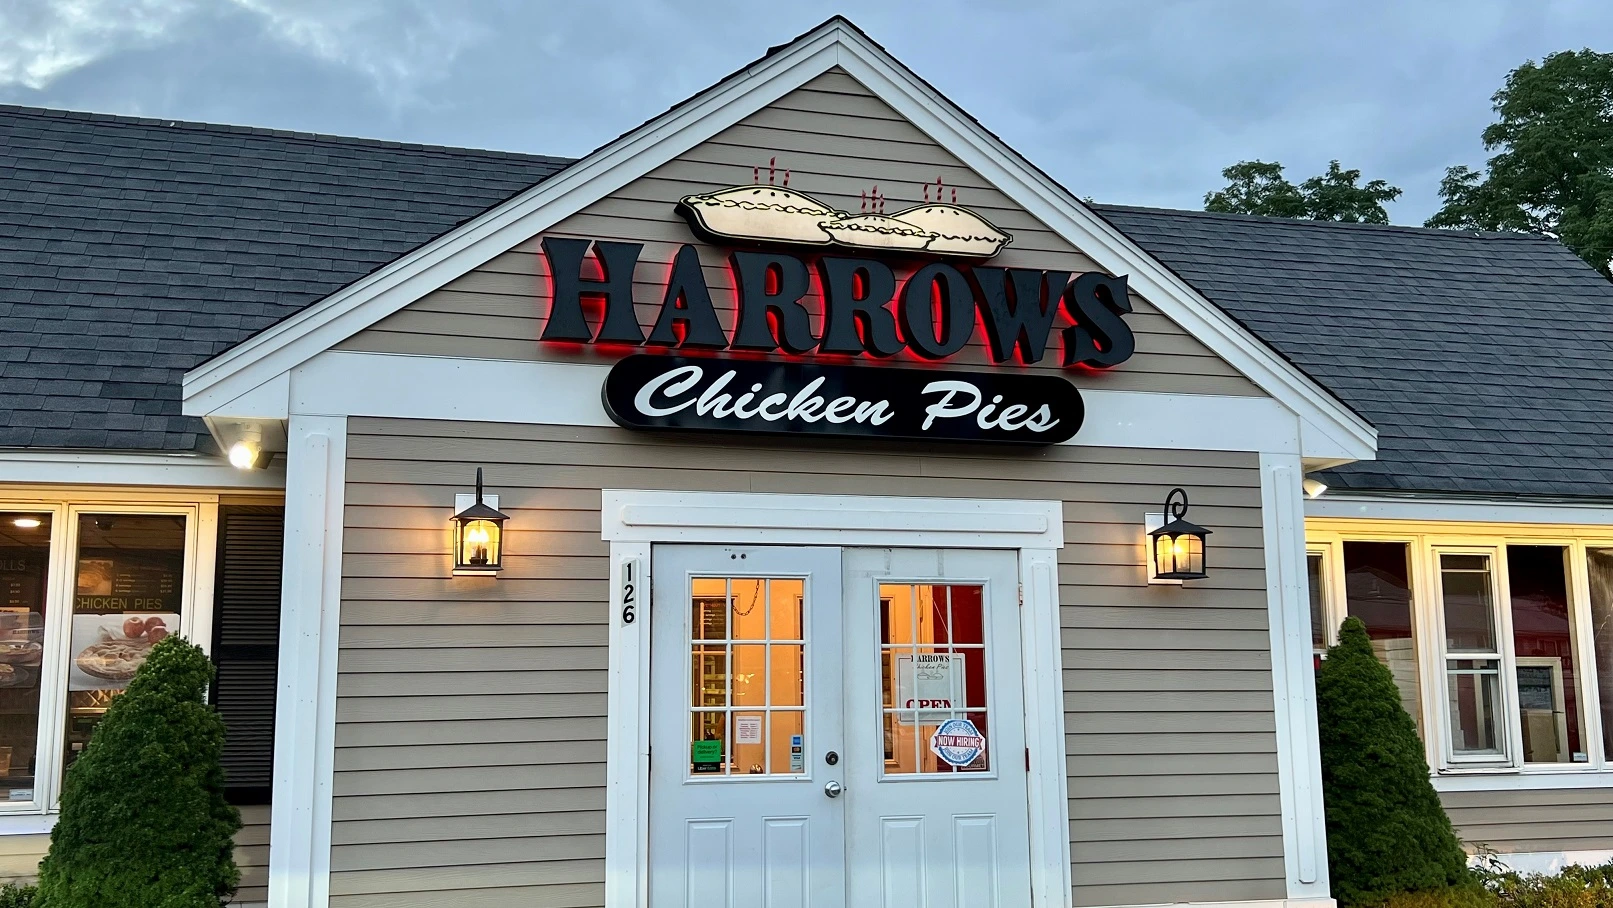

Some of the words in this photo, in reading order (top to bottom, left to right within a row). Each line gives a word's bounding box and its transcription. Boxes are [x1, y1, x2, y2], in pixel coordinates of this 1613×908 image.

[541, 236, 1136, 370] HARROWS
[634, 365, 894, 426] Chicken
[919, 380, 1060, 433] Pies
[134, 598, 162, 610] PIES
[938, 735, 954, 746] NOW
[956, 736, 980, 747] HIRING
